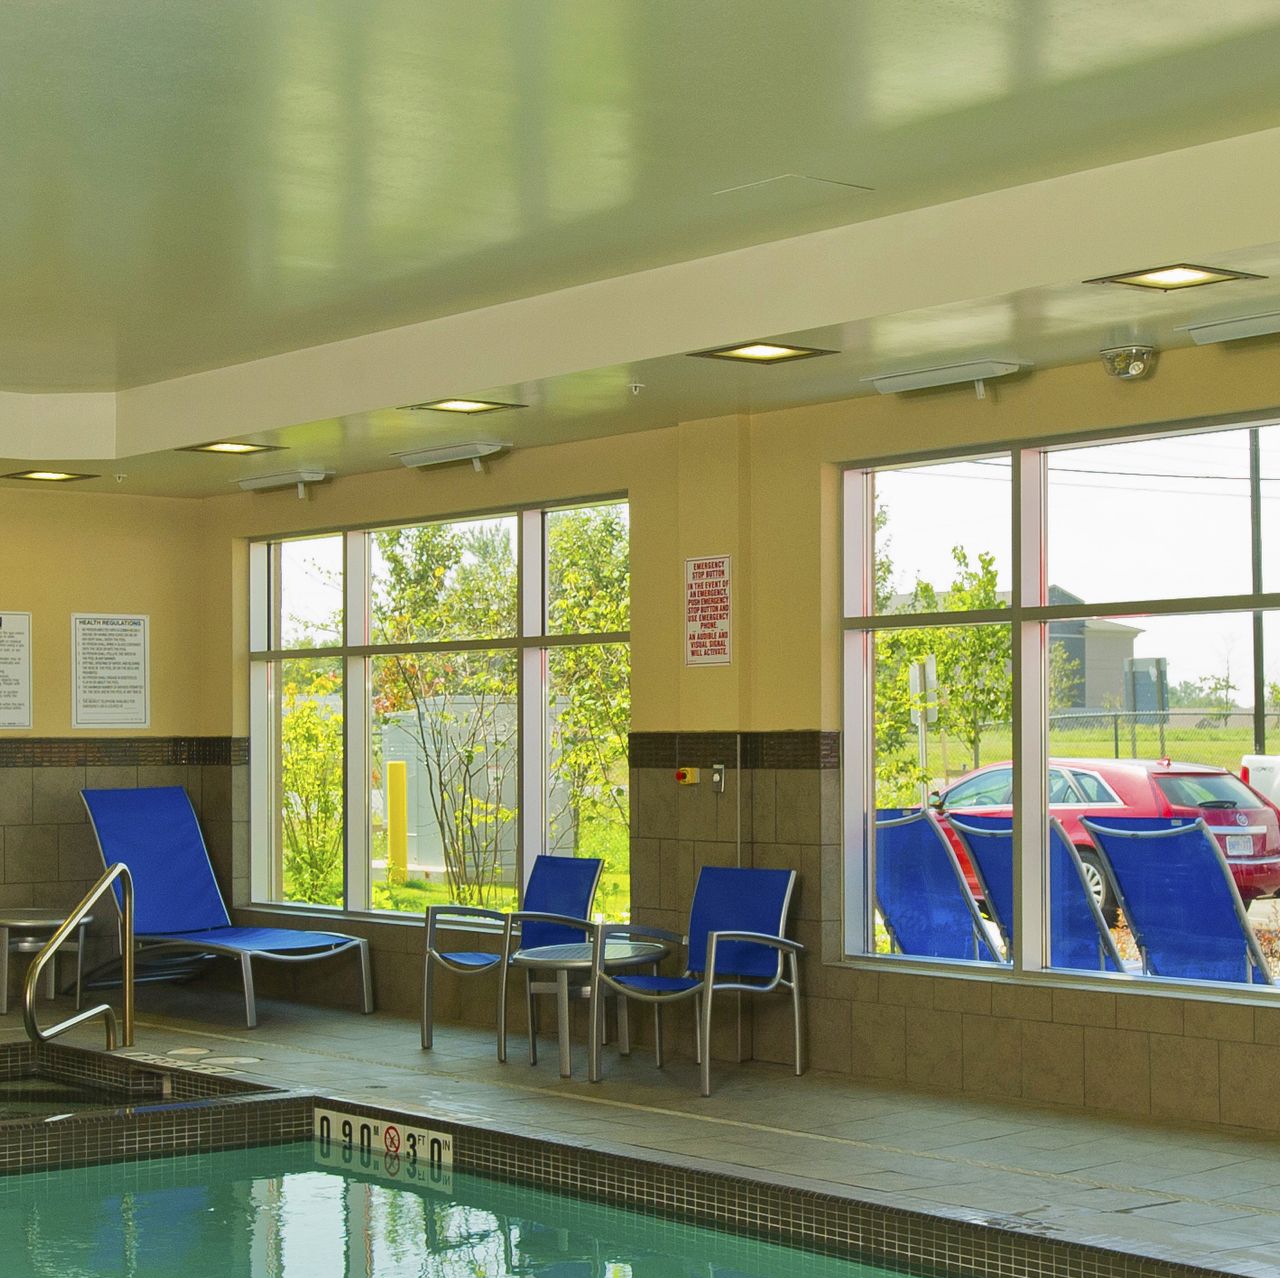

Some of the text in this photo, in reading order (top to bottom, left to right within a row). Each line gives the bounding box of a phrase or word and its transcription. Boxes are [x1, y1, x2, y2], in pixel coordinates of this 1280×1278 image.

[694, 561, 724, 570] EMERGENCY
[692, 571, 704, 579] STOP
[699, 613, 728, 621] EMERGENCY
